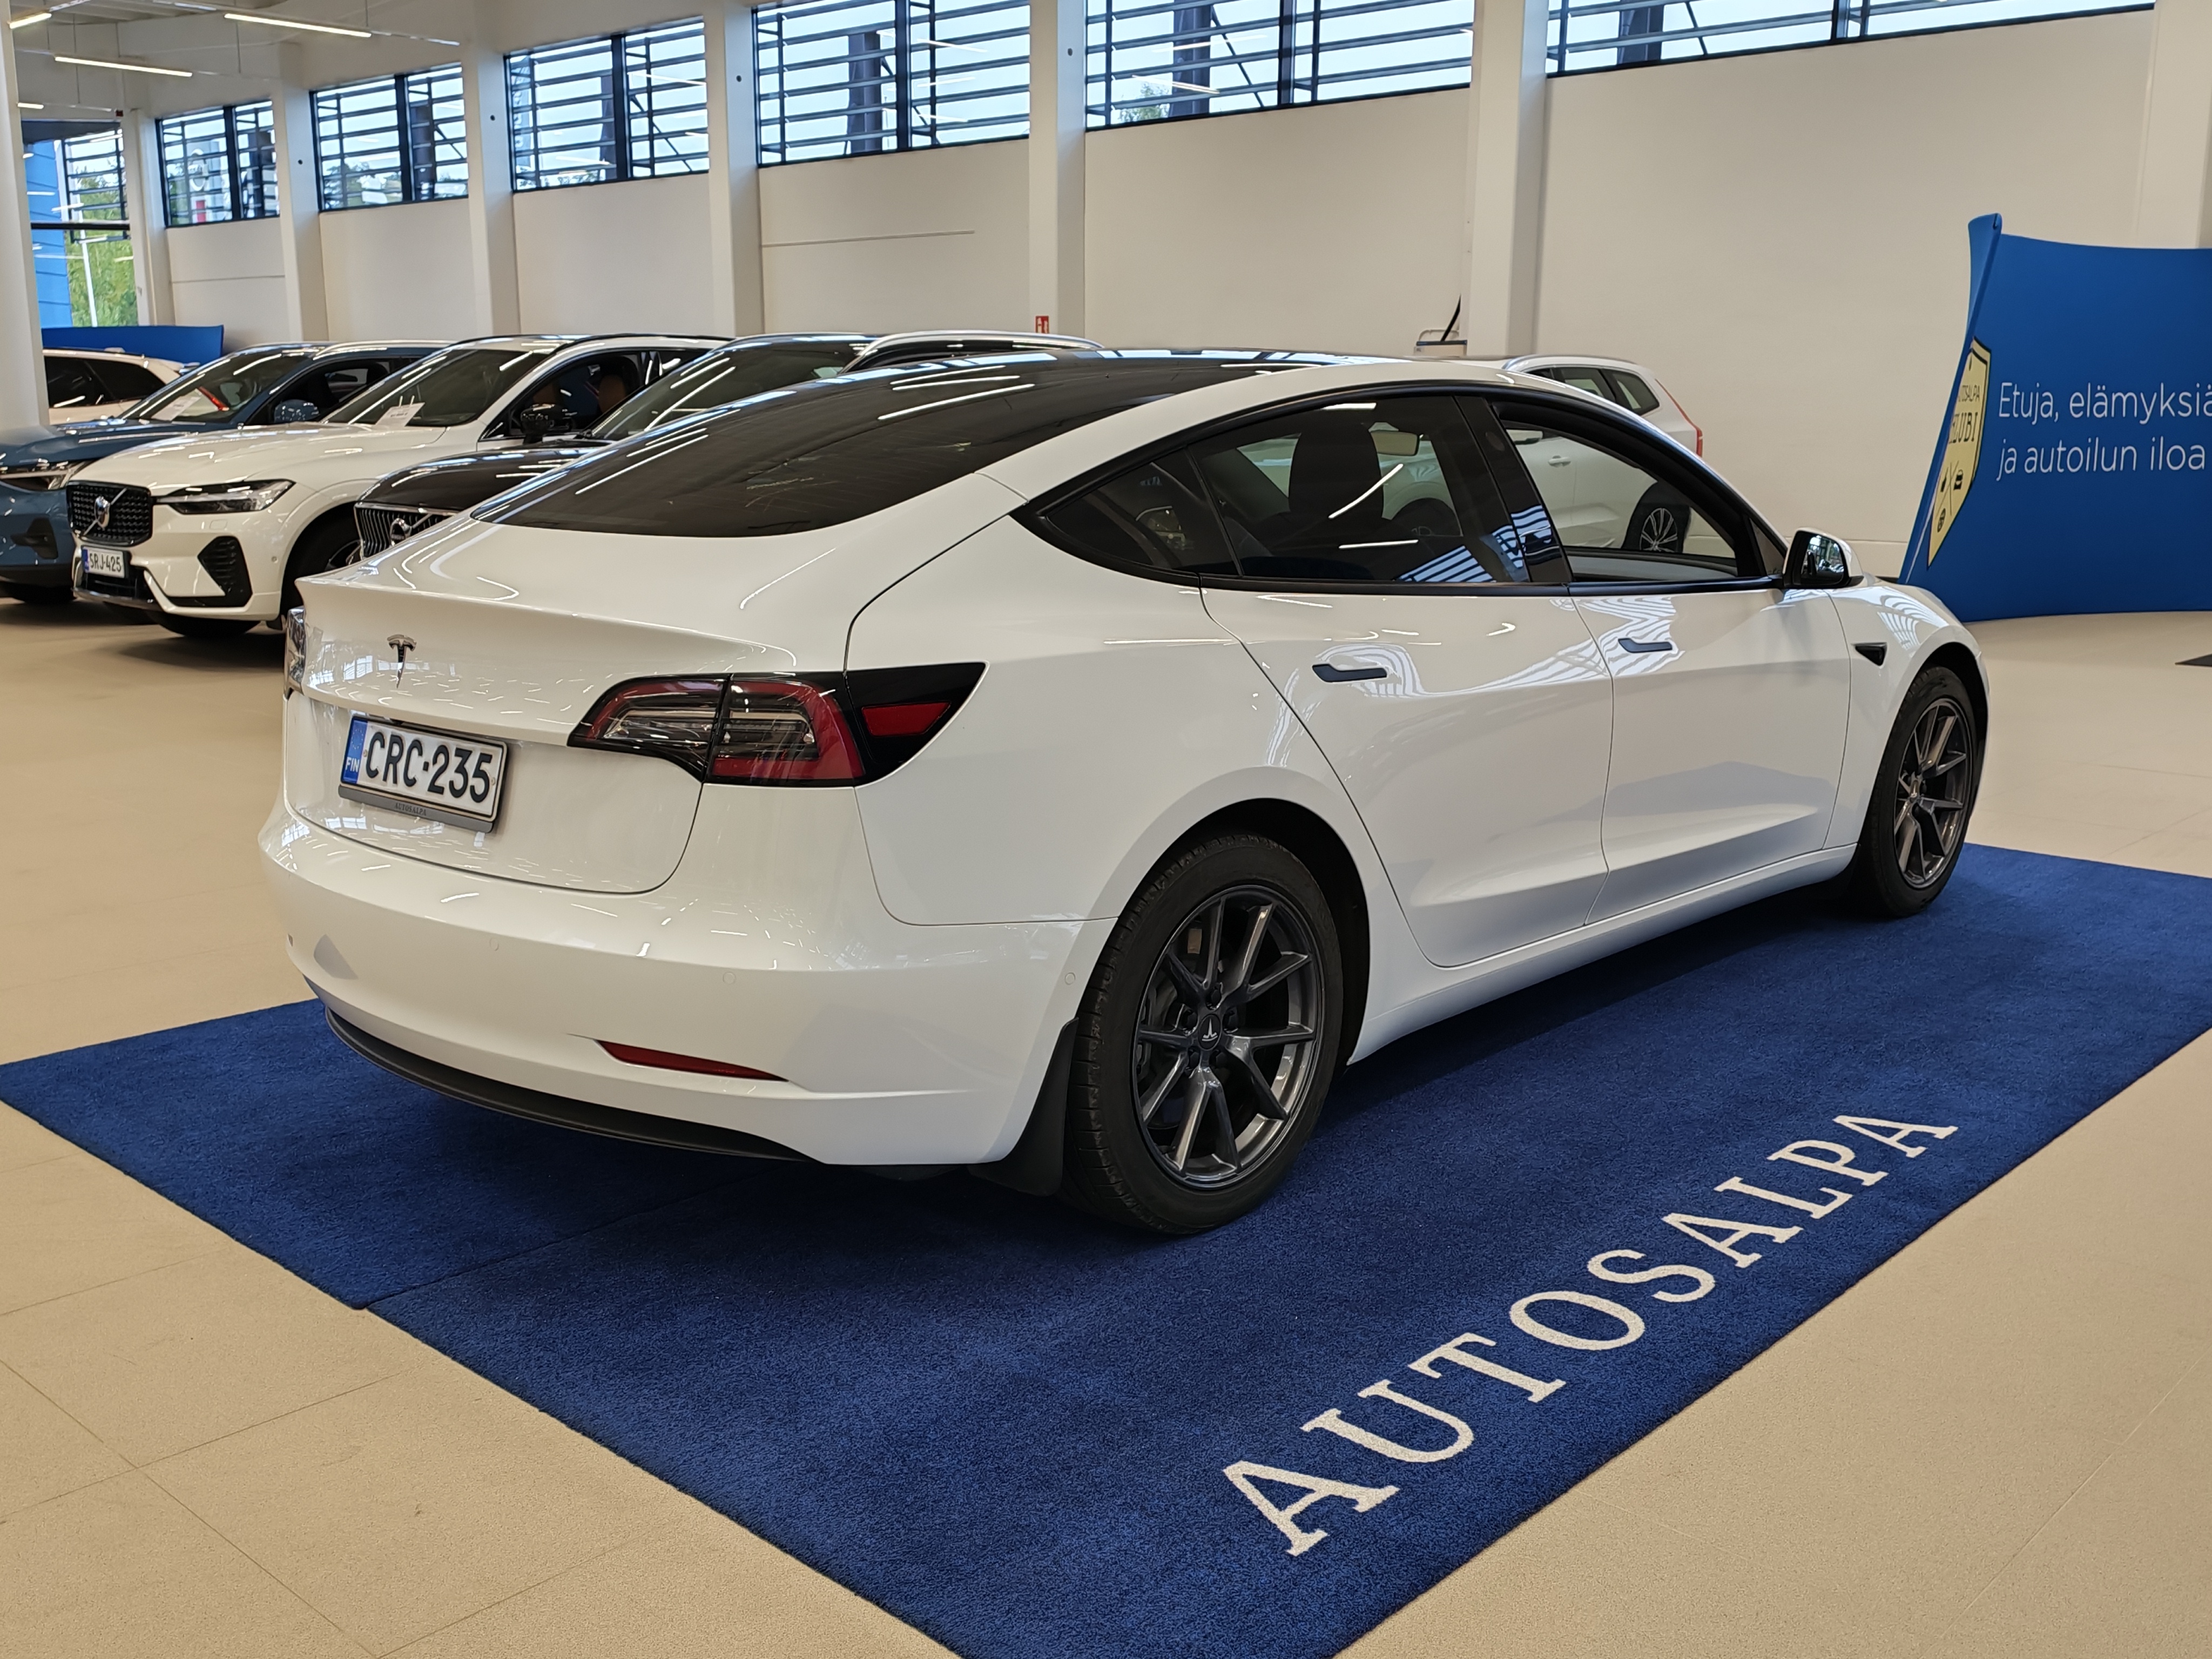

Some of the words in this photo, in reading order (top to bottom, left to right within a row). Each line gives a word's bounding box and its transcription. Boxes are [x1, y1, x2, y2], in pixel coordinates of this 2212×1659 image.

[1999, 382, 2059, 425] Etuja,
[2069, 382, 2212, 424] elämyksiä
[1996, 438, 2017, 481] ja
[2024, 436, 2137, 474] autoilun
[2150, 435, 2206, 471] iloa
[89, 552, 122, 573] SRJ-425
[345, 756, 360, 773] FIN
[366, 731, 493, 803] CRC-235
[395, 802, 427, 816] AUTOSALPA
[1222, 1114, 1958, 1555] AUTOSALPA
